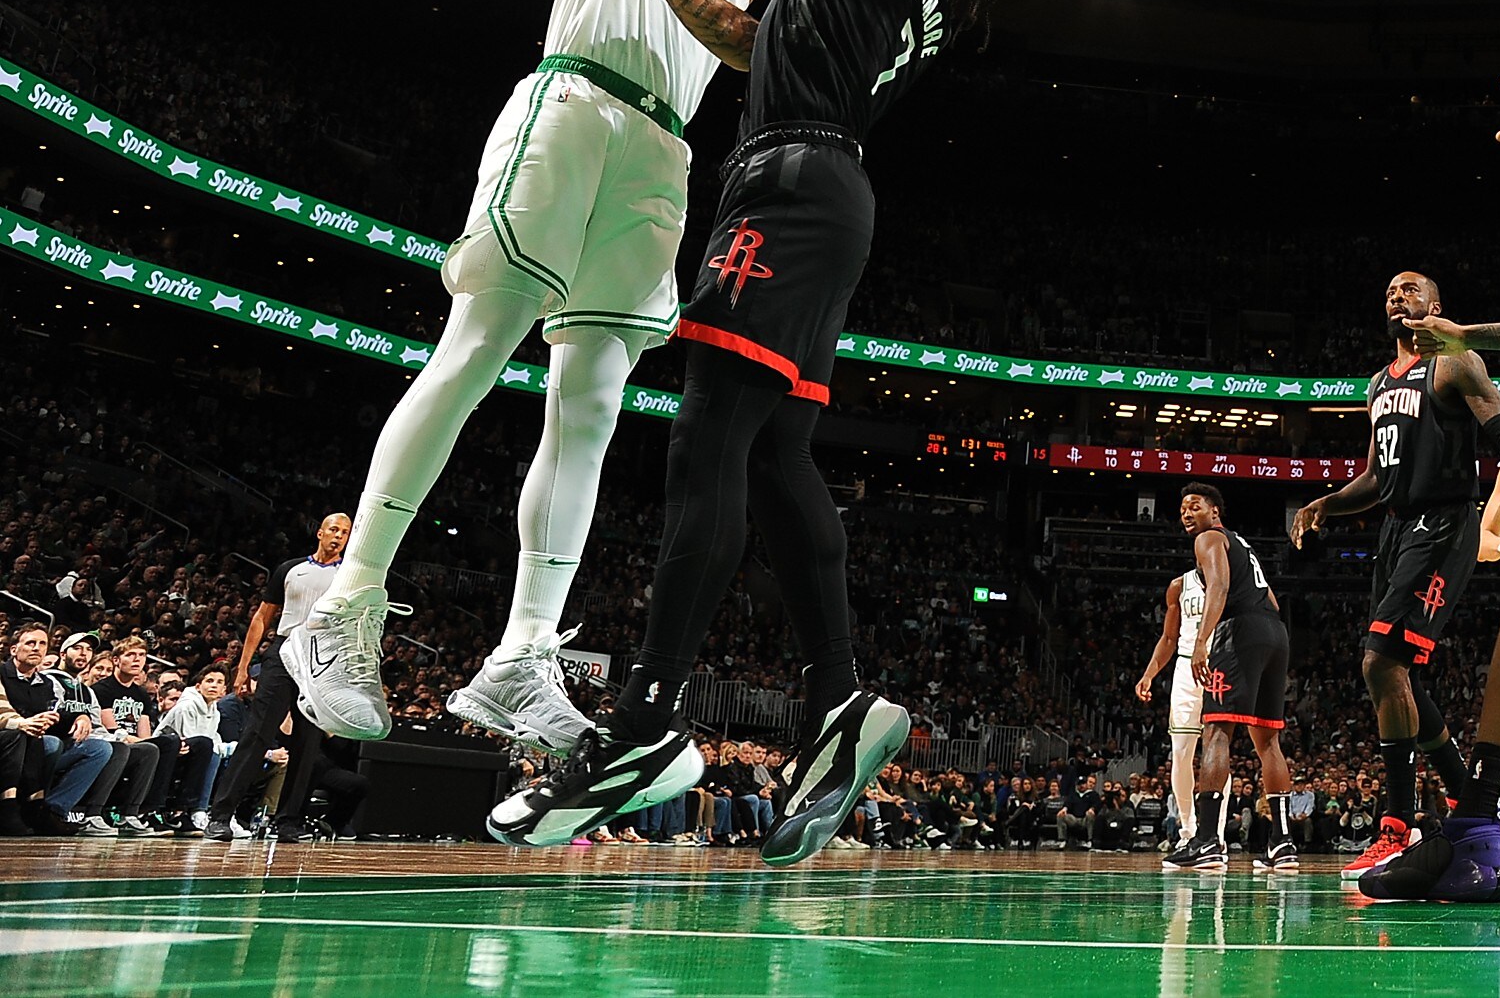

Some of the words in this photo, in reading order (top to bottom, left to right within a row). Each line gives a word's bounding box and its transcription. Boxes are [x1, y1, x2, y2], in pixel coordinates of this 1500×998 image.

[871, 17, 915, 95] 7
[28, 84, 78, 120] Sprite
[118, 130, 163, 163] Sprite
[209, 169, 263, 199] Sprite
[310, 204, 359, 233] Sprite
[401, 236, 447, 264] Sprite
[45, 237, 92, 268] Sprite
[145, 271, 201, 300] Sprite
[251, 301, 302, 328] Sprite
[346, 329, 393, 354] Sprite
[633, 392, 680, 414] Sprite
[864, 341, 910, 360] Sprite
[954, 354, 999, 373] Sprite
[1042, 365, 1088, 383] Sprite
[1133, 371, 1178, 389] Sprite
[1222, 377, 1267, 395] Sprite
[1310, 381, 1355, 399] Sprite
[926, 443, 940, 454] 28
[993, 451, 1007, 461] 29
[1033, 448, 1046, 460] 15
[1105, 457, 1118, 468] 10
[1133, 459, 1141, 469] 8
[1160, 461, 1168, 471] 2
[1185, 462, 1192, 472] 3
[1211, 463, 1236, 474] 4/10
[1251, 465, 1278, 477] 11/22
[1290, 468, 1303, 478] 50
[1322, 468, 1330, 478] 6
[1347, 468, 1354, 478] 5
[1376, 424, 1400, 468] 32
